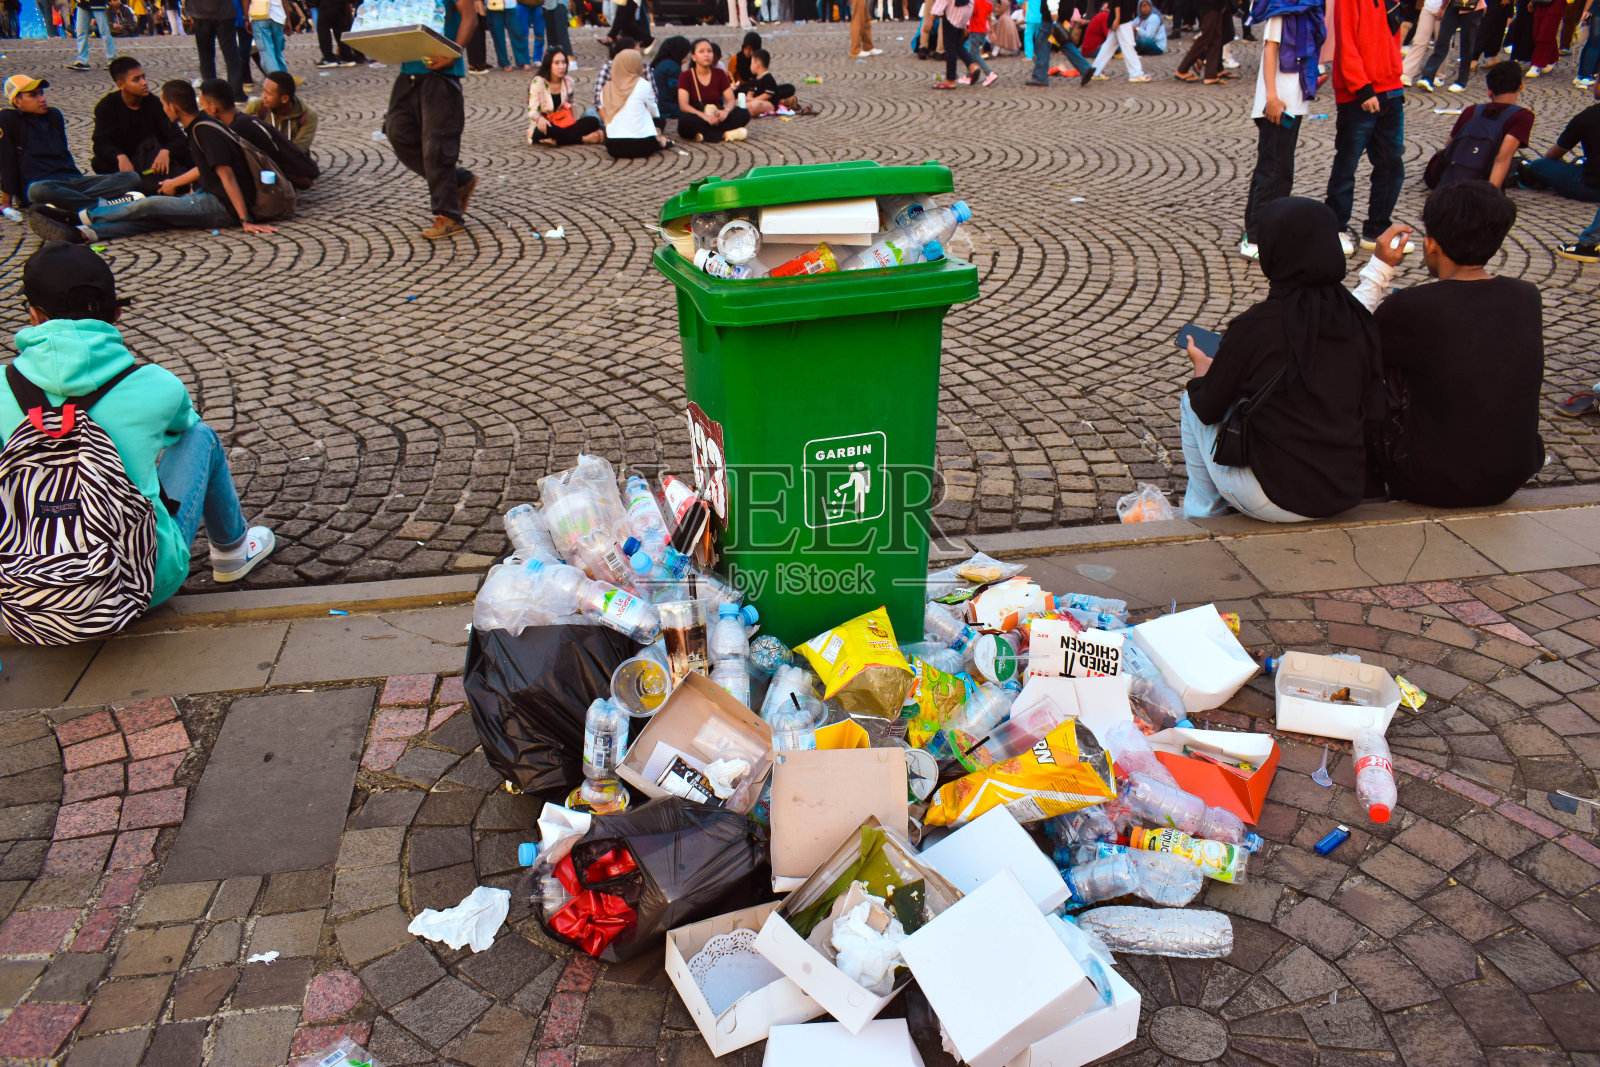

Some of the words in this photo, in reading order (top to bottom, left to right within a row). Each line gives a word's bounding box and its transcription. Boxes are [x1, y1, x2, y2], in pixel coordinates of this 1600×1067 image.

[815, 443, 873, 461] GARBIN
[1060, 635, 1119, 662] CHICKEN
[1079, 654, 1119, 677] FRIED
